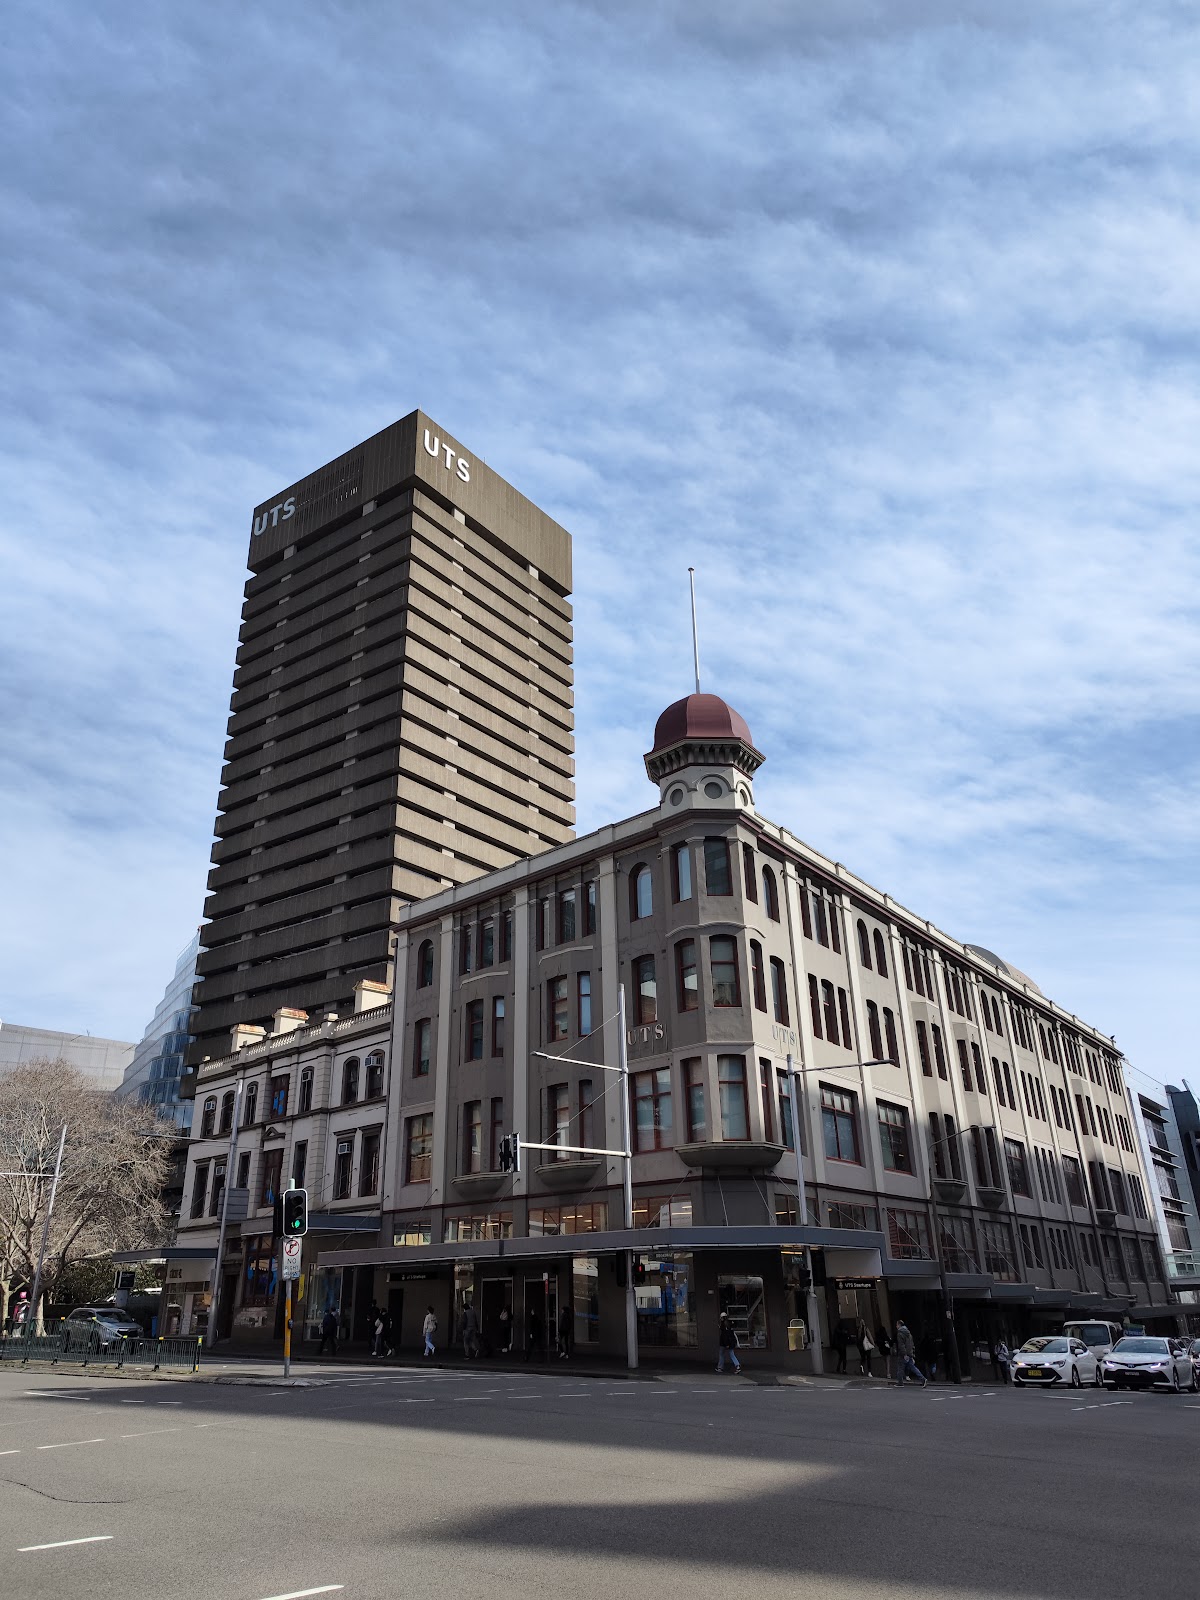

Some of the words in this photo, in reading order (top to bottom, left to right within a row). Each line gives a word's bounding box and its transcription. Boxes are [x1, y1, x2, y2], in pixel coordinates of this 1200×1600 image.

[423, 428, 470, 482] UTS
[253, 496, 296, 536] UTS
[627, 1023, 664, 1046] UTS
[771, 1024, 797, 1046] UTS
